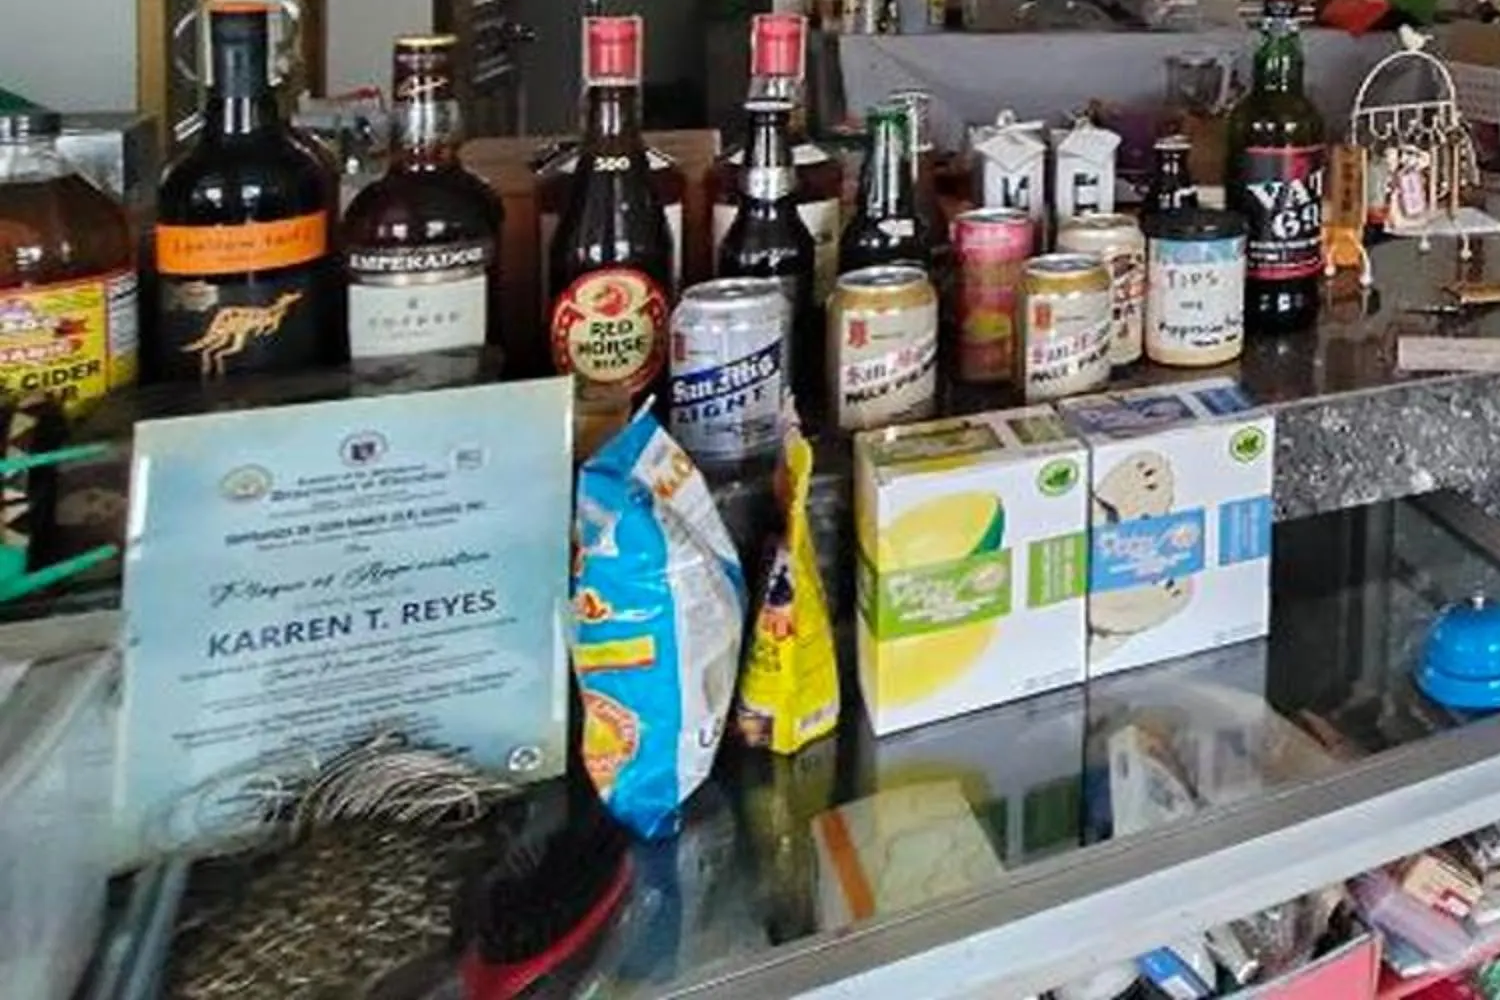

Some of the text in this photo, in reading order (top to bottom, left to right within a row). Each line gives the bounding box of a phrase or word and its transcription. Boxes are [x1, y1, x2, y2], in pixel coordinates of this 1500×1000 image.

[593, 156, 631, 171] 500
[591, 320, 633, 337] RED
[576, 338, 647, 356] HORSE
[21, 359, 100, 390] CIDER
[208, 615, 352, 658] KARREN
[364, 608, 389, 631] T.
[401, 589, 497, 626] REYES
